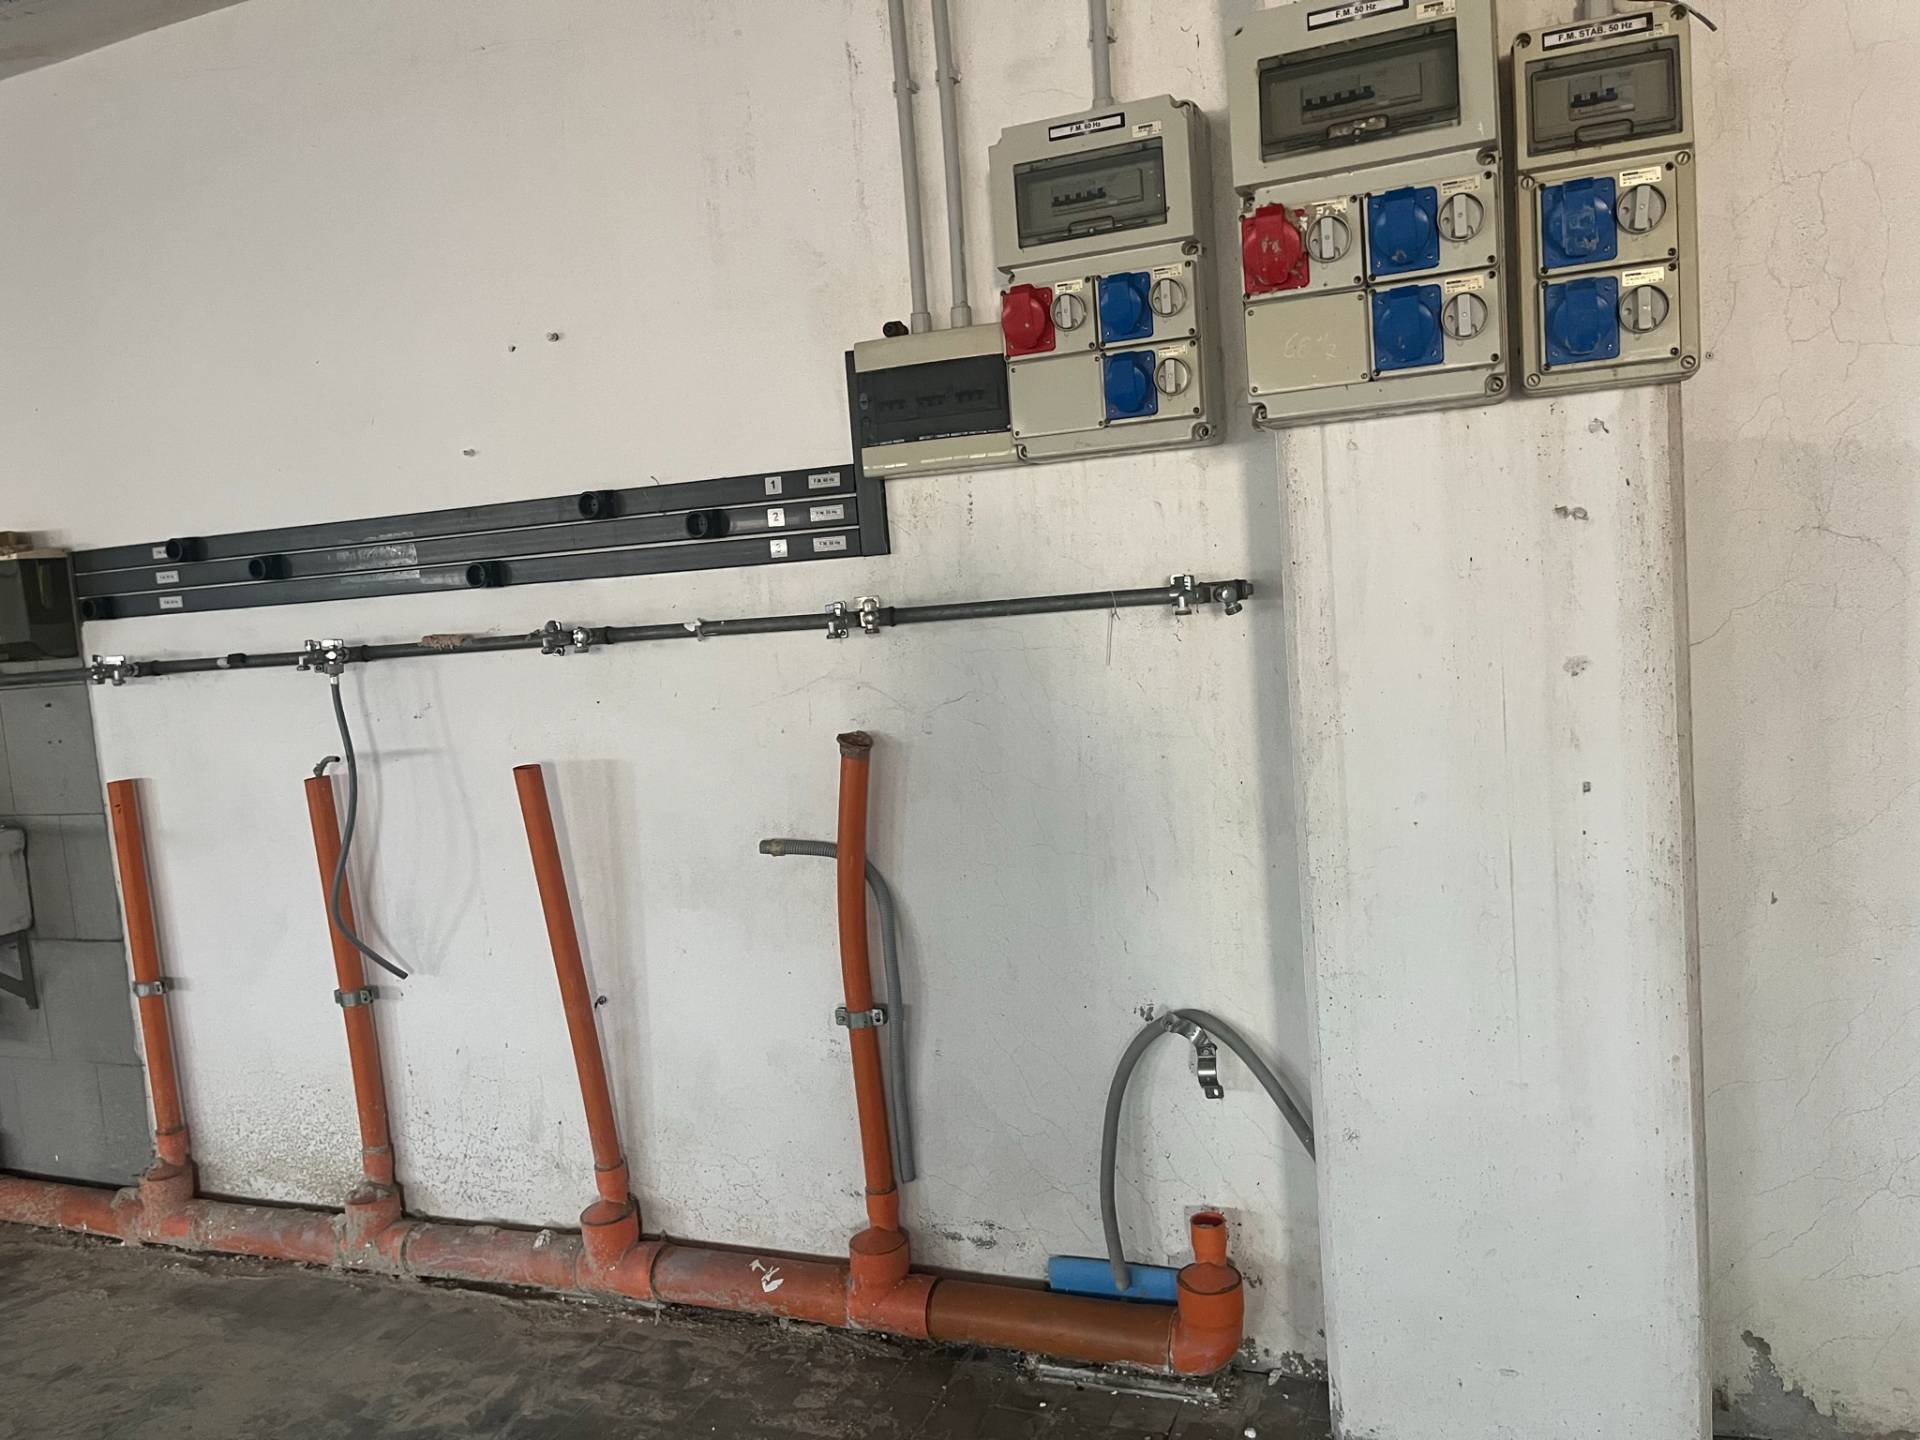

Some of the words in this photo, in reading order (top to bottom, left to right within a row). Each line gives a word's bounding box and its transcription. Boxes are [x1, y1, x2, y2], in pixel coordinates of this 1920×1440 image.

[1335, 8, 1352, 18] F.M.
[1354, 6, 1364, 14] 50
[1366, 3, 1377, 12] Hz
[1558, 32, 1577, 42] F.M.
[1579, 26, 1606, 38] STAB.
[1609, 23, 1619, 32] 50
[1621, 22, 1633, 30] Hz
[773, 511, 780, 522] 2
